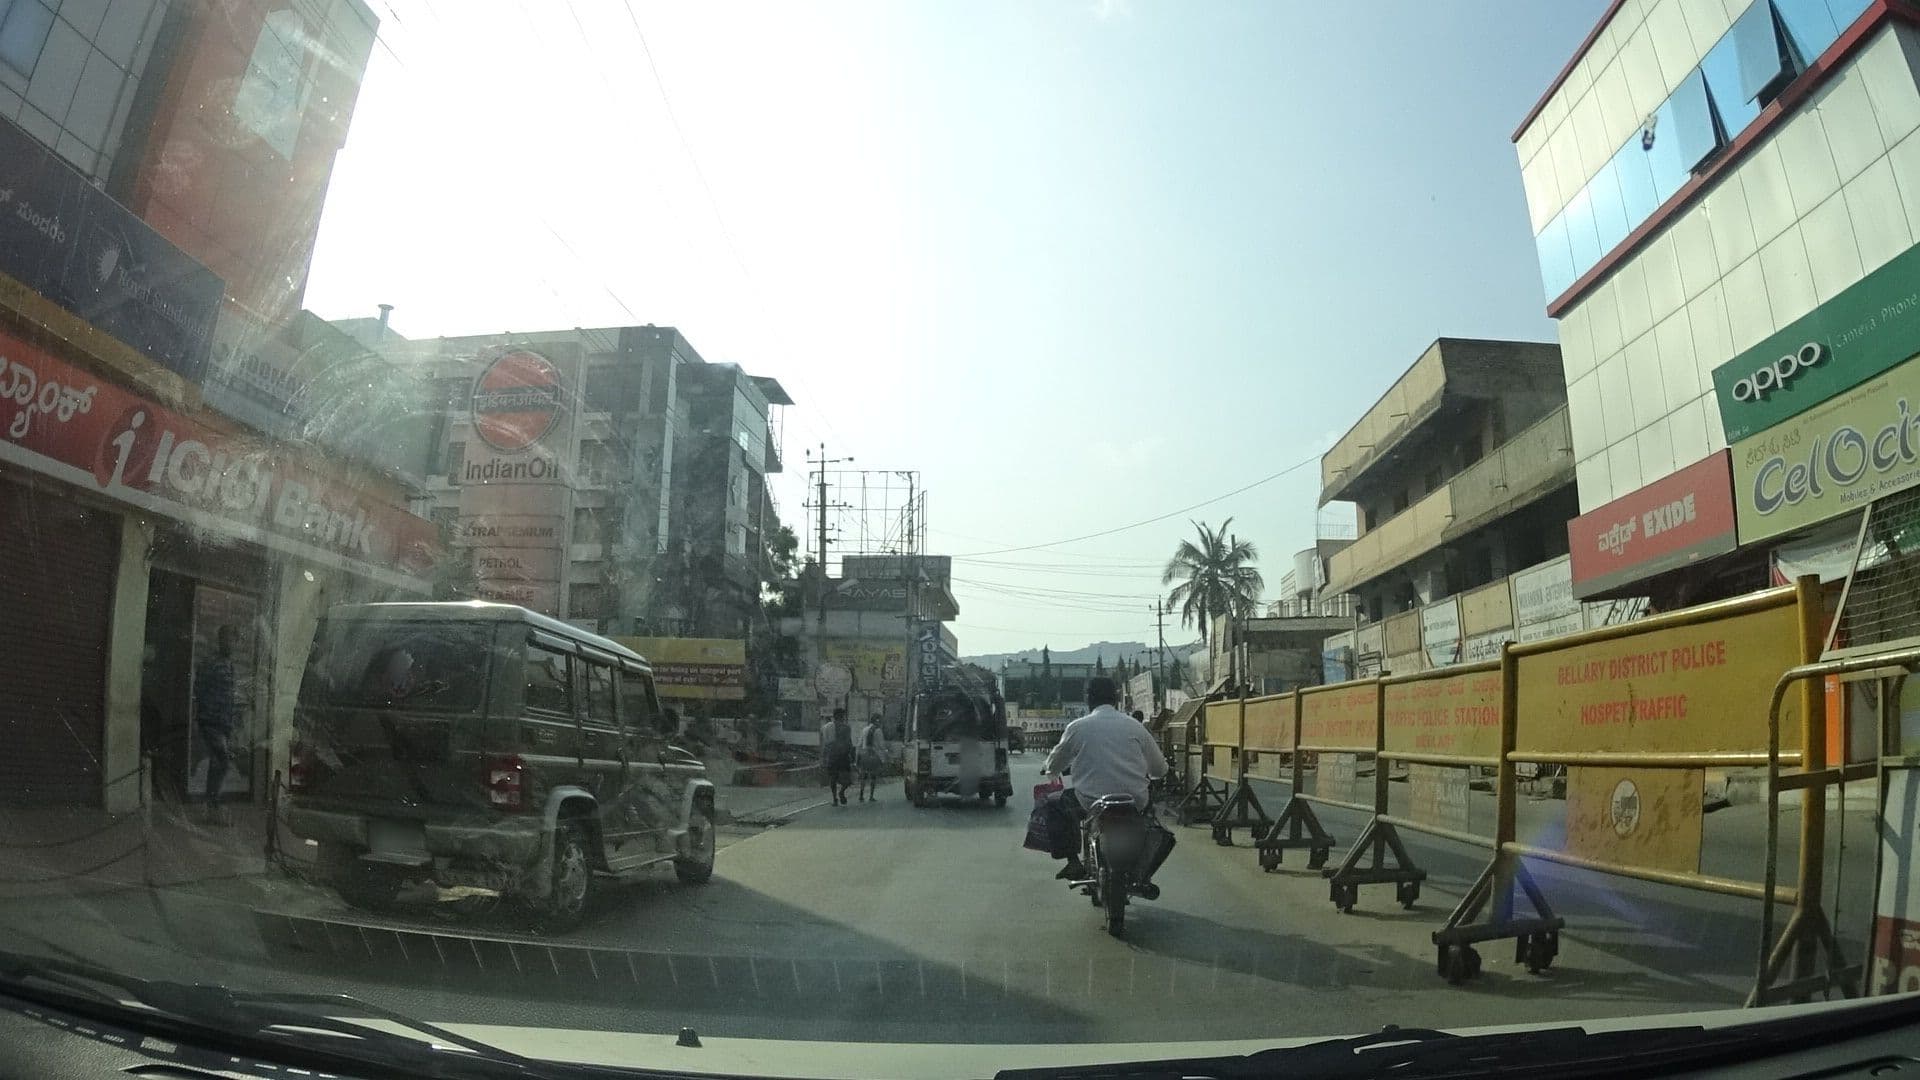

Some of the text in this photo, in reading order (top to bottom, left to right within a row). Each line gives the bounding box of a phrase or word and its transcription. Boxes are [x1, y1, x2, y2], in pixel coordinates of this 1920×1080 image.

[465, 457, 559, 480] IndianOil
[147, 430, 273, 512] ICICI
[274, 479, 375, 554] Bank
[1643, 492, 1696, 540] EXIDE
[1558, 640, 1727, 686] BELLARY DISTRICT POLICE
[1417, 708, 1449, 728] POLICE
[1455, 704, 1500, 727] STATION
[1581, 694, 1688, 726] HOSPET TRAFFIC
